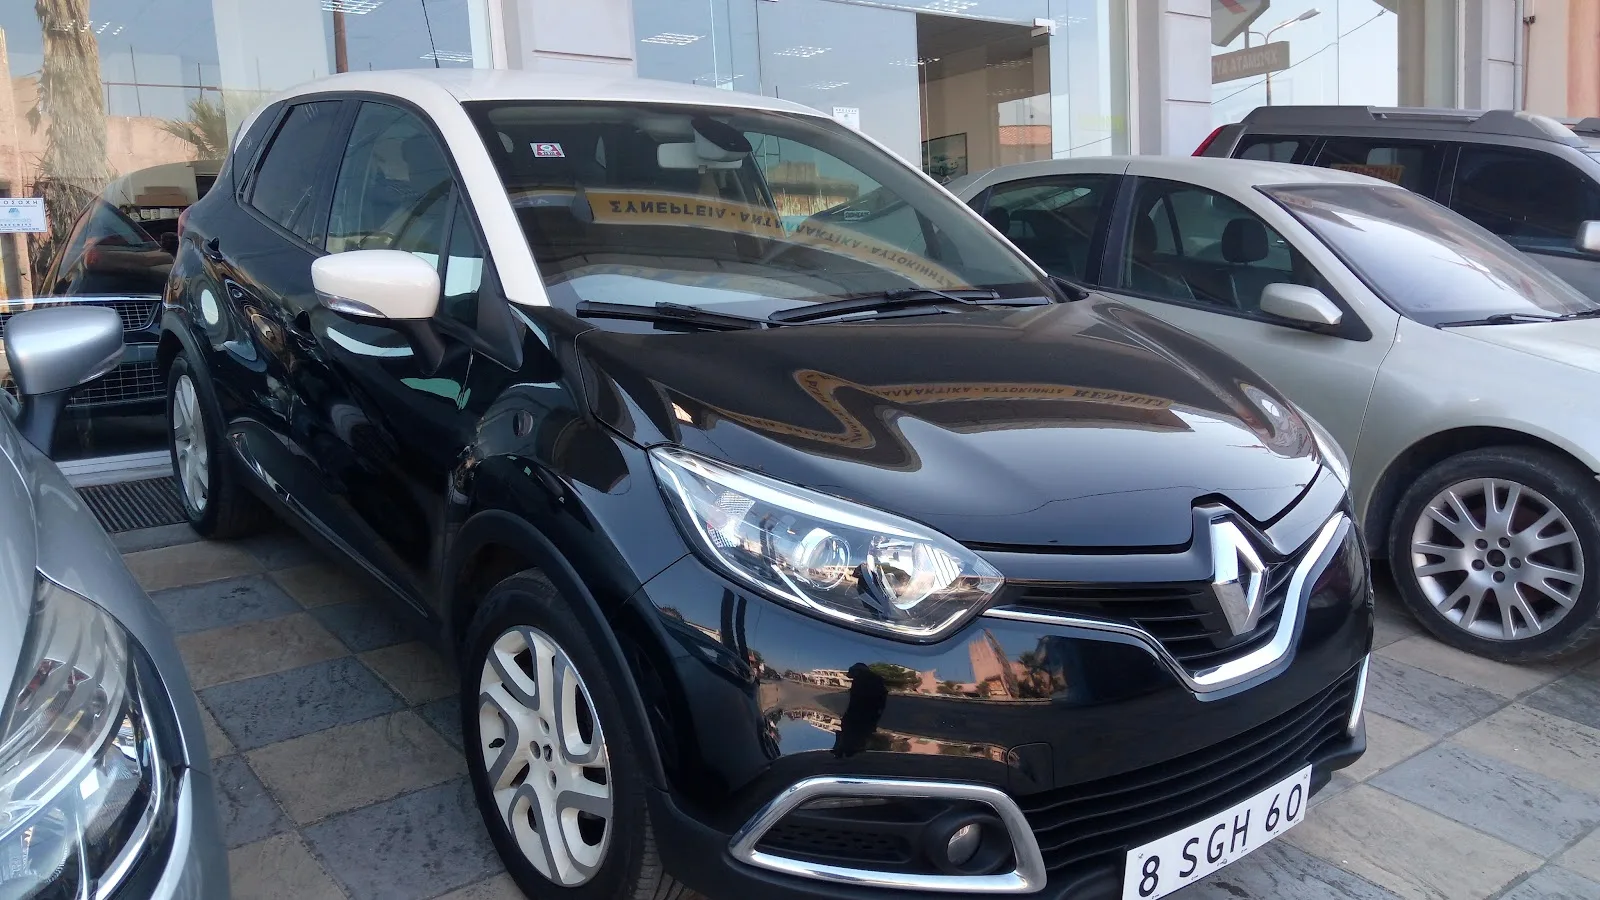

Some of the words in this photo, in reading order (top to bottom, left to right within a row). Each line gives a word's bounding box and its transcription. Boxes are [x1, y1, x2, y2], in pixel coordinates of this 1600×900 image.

[1138, 855, 1160, 898] 8
[1179, 809, 1251, 878] SGH
[1265, 783, 1302, 832] 60
